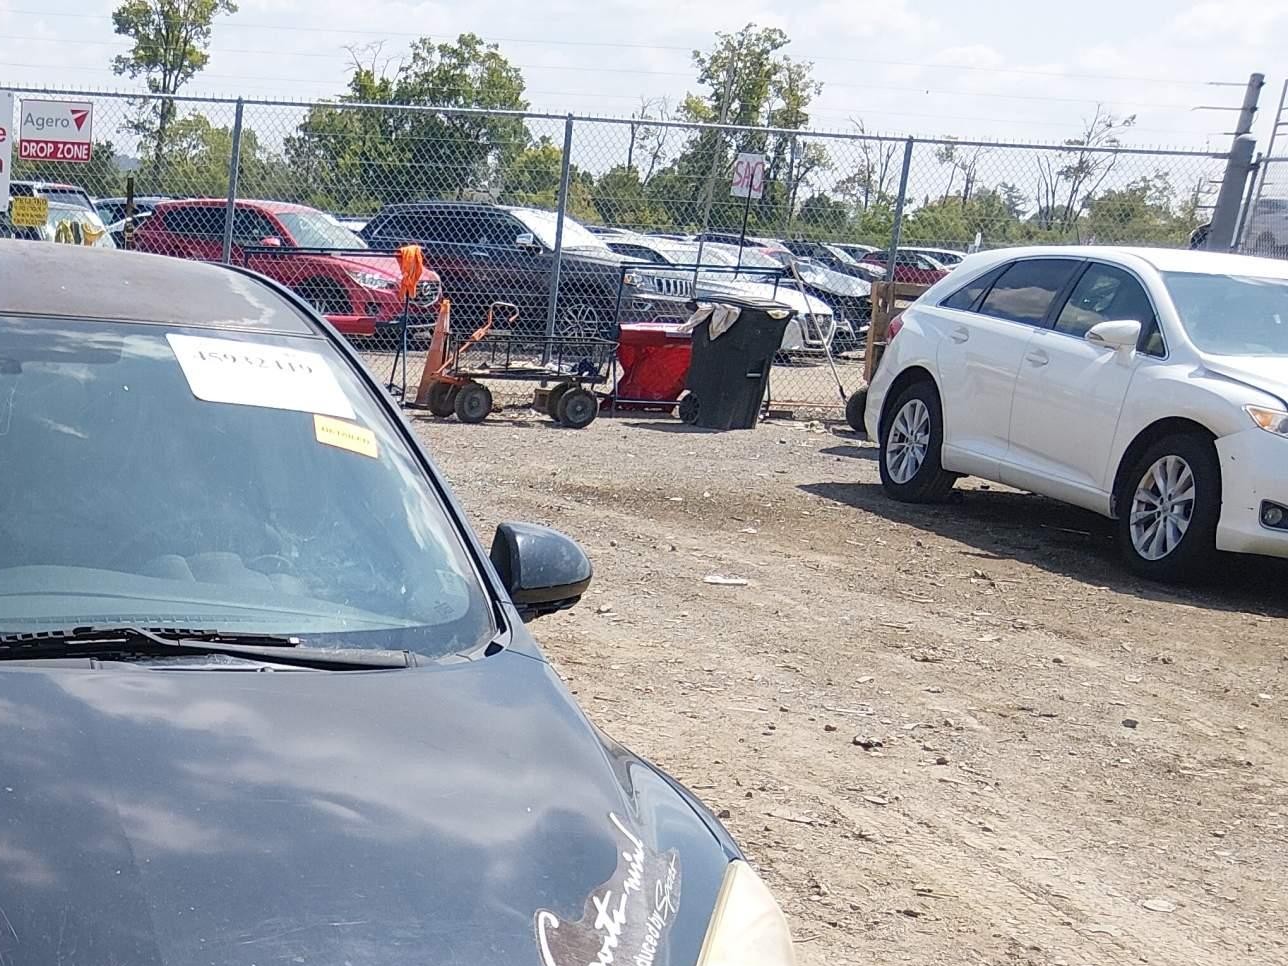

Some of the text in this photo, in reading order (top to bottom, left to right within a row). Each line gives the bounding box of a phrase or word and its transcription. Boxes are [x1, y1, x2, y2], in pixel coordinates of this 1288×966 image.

[24, 113, 70, 131] Agero
[21, 142, 89, 160] DROP ZONE
[647, 909, 667, 930] by
